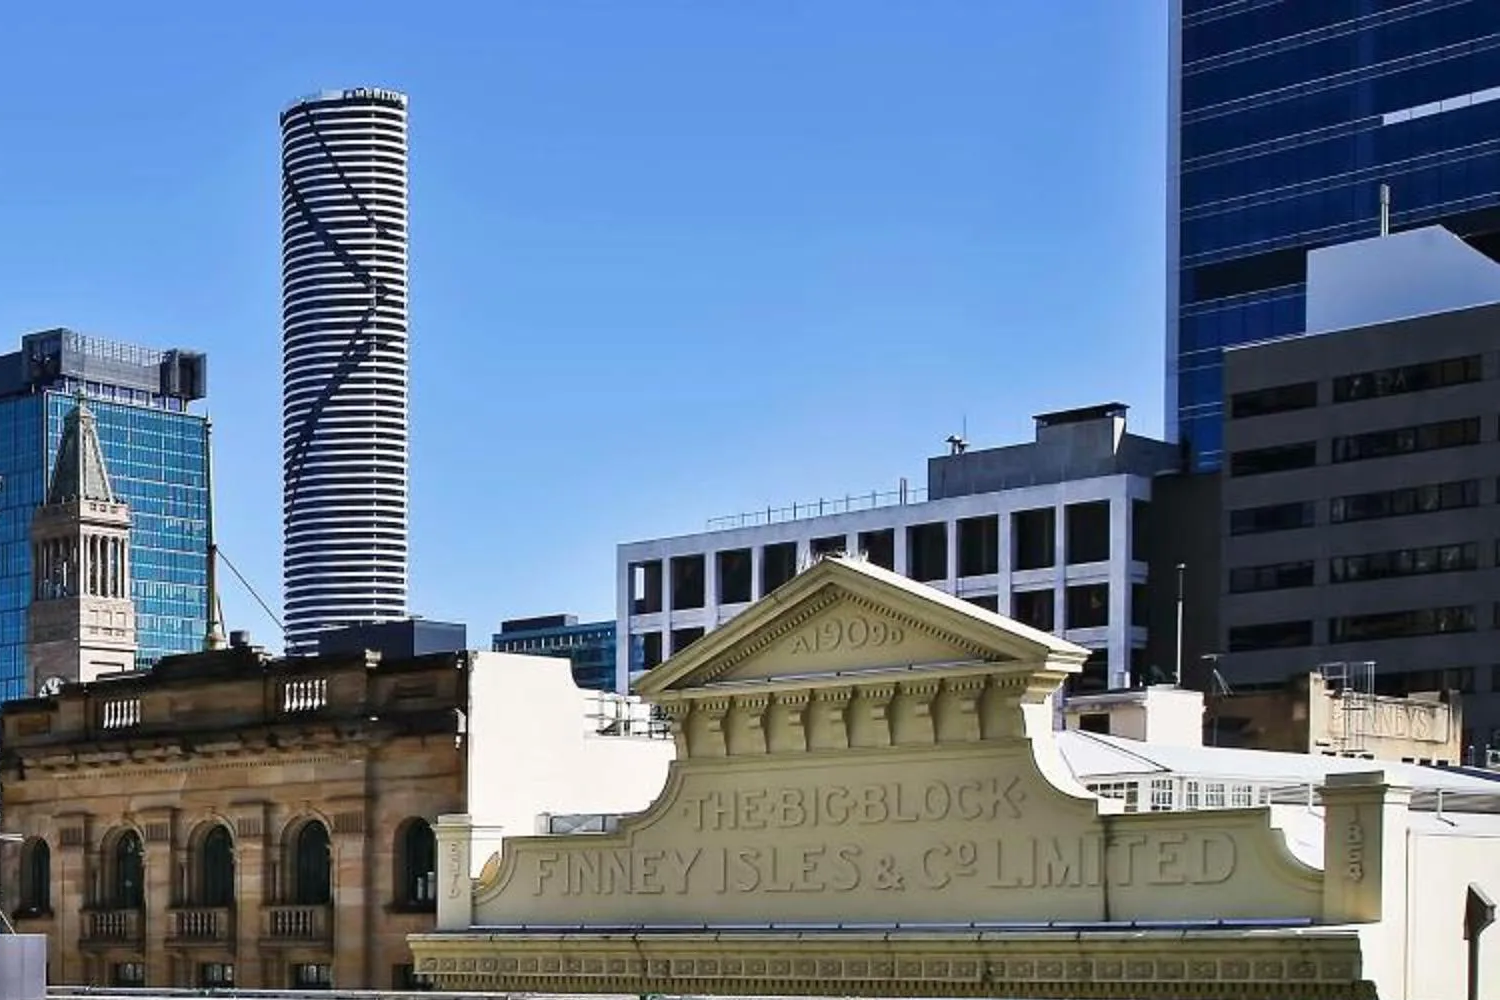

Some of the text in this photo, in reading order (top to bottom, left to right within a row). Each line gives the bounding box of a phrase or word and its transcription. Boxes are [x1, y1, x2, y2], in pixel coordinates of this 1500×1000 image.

[533, 848, 703, 897] FINNEY
[714, 843, 863, 894] ISLES
[874, 852, 907, 893] &
[987, 832, 1238, 890] LIMITED
